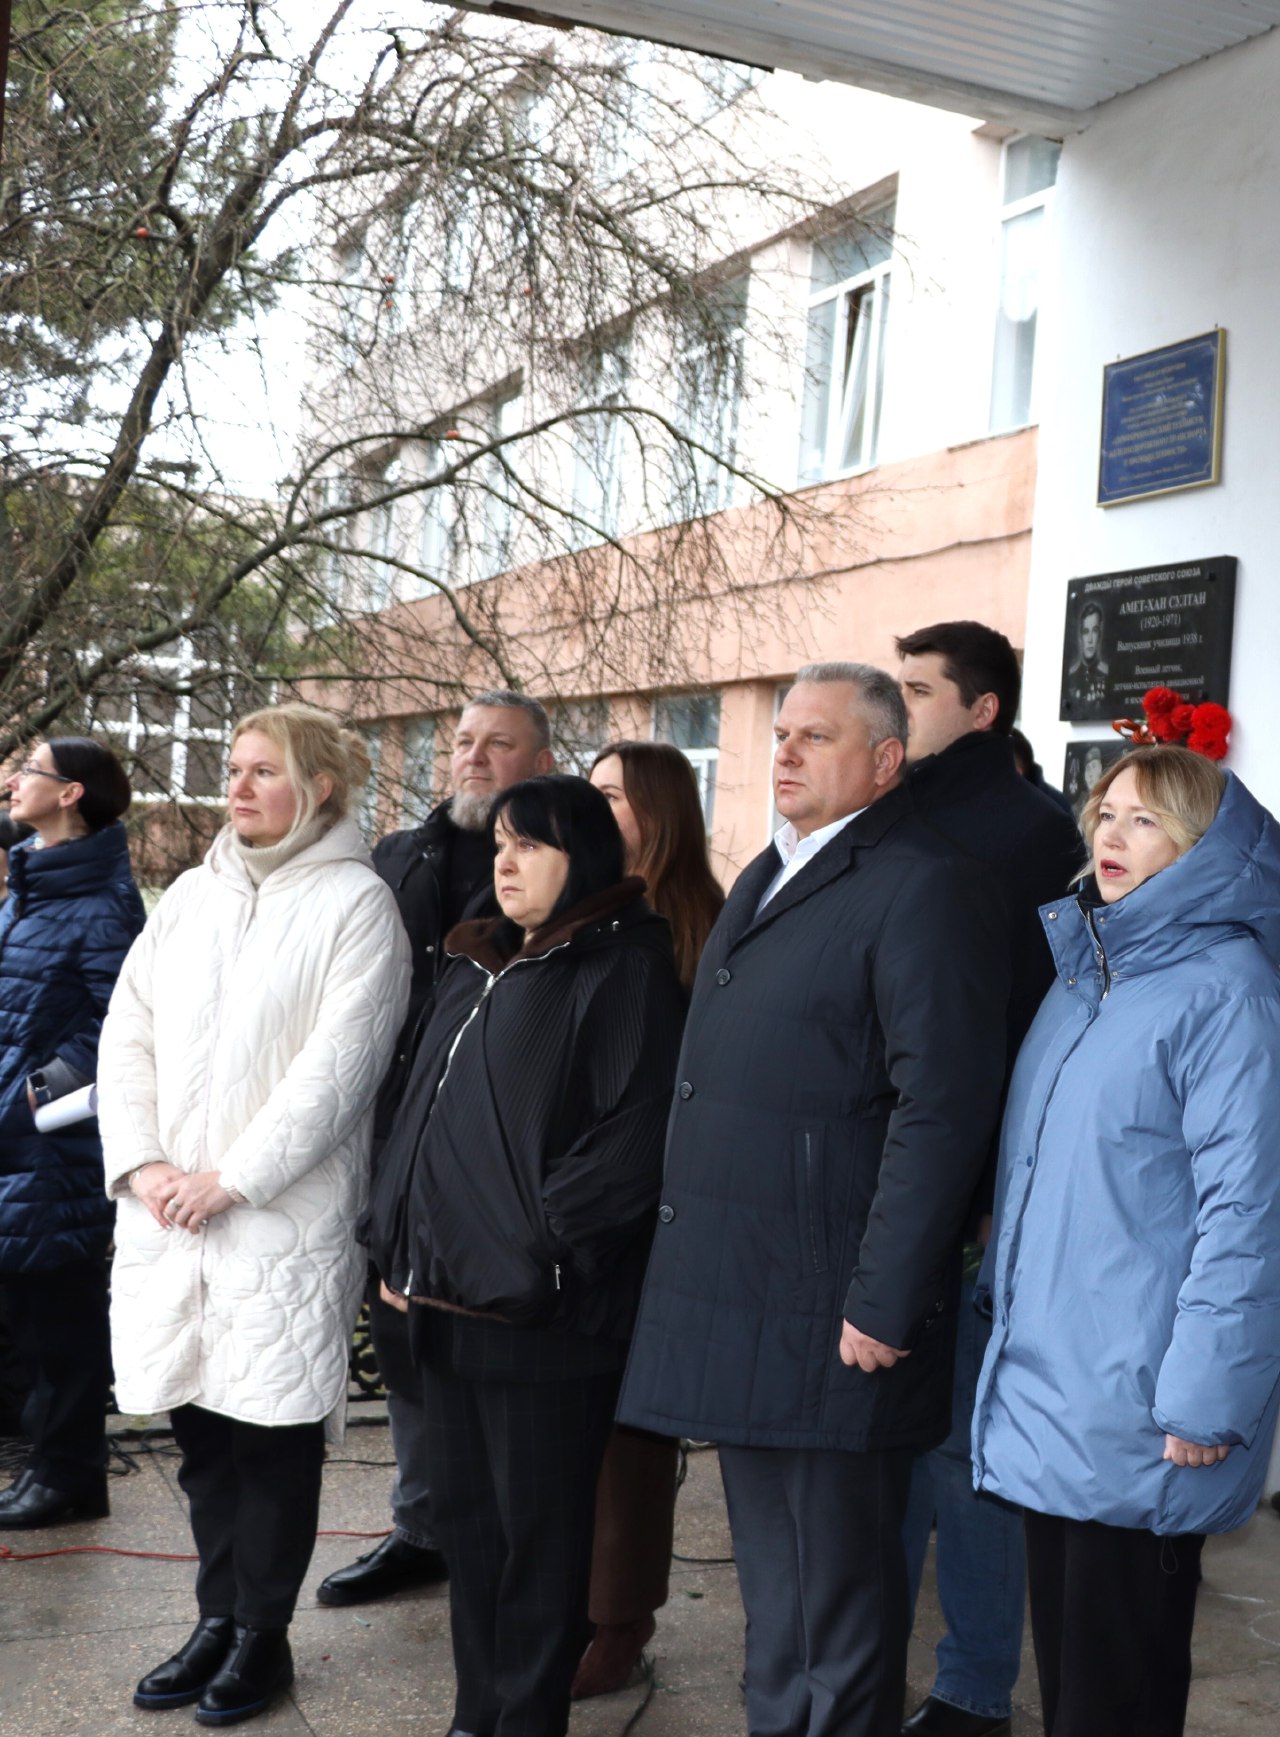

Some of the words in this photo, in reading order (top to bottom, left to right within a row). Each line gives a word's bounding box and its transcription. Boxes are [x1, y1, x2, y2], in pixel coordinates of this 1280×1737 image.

[1112, 575, 1133, 589] ГЕРОЙ
[1134, 571, 1176, 585] СОВЕТСКОГО
[1176, 567, 1201, 580] СОЮЗА
[1119, 597, 1167, 615] АМЕТ-ХАН
[1168, 591, 1207, 609] СУЛТАН
[1140, 614, 1181, 631] (1920-1971)
